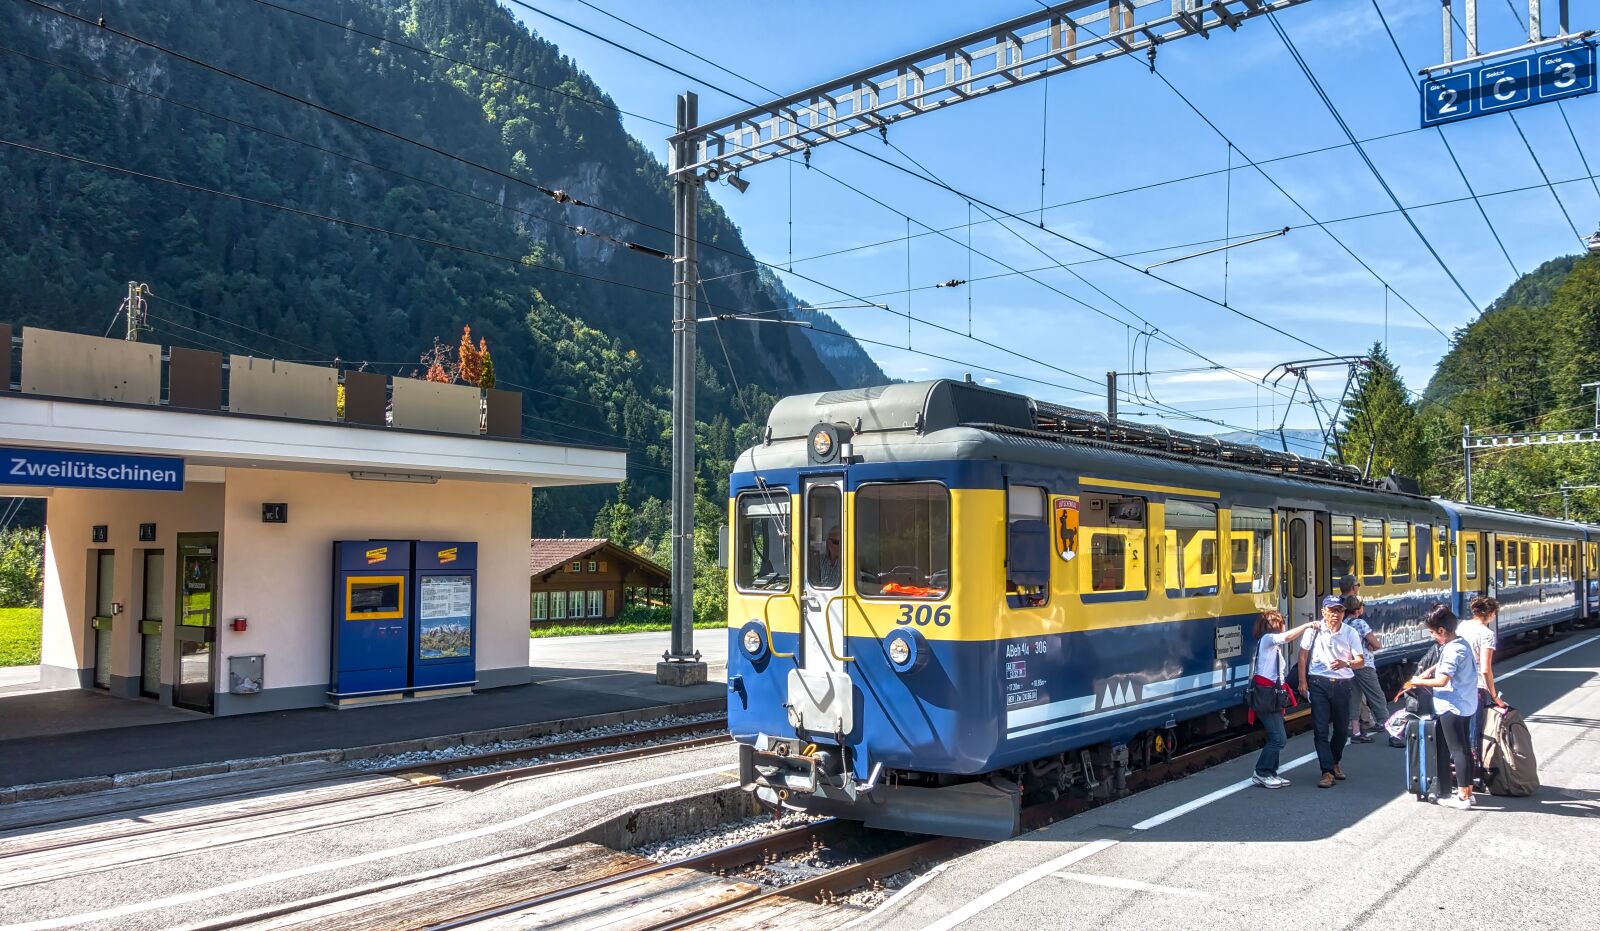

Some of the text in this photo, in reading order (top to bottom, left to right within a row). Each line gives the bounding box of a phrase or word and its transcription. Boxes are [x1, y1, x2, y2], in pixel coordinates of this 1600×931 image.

[1554, 63, 1576, 88] 3
[1493, 76, 1516, 100] C
[1438, 89, 1458, 114] 2
[9, 458, 177, 483] Zweilütschinen
[896, 604, 951, 627] 306
[1006, 643, 1021, 658] ABeh
[1035, 641, 1047, 654] 306
